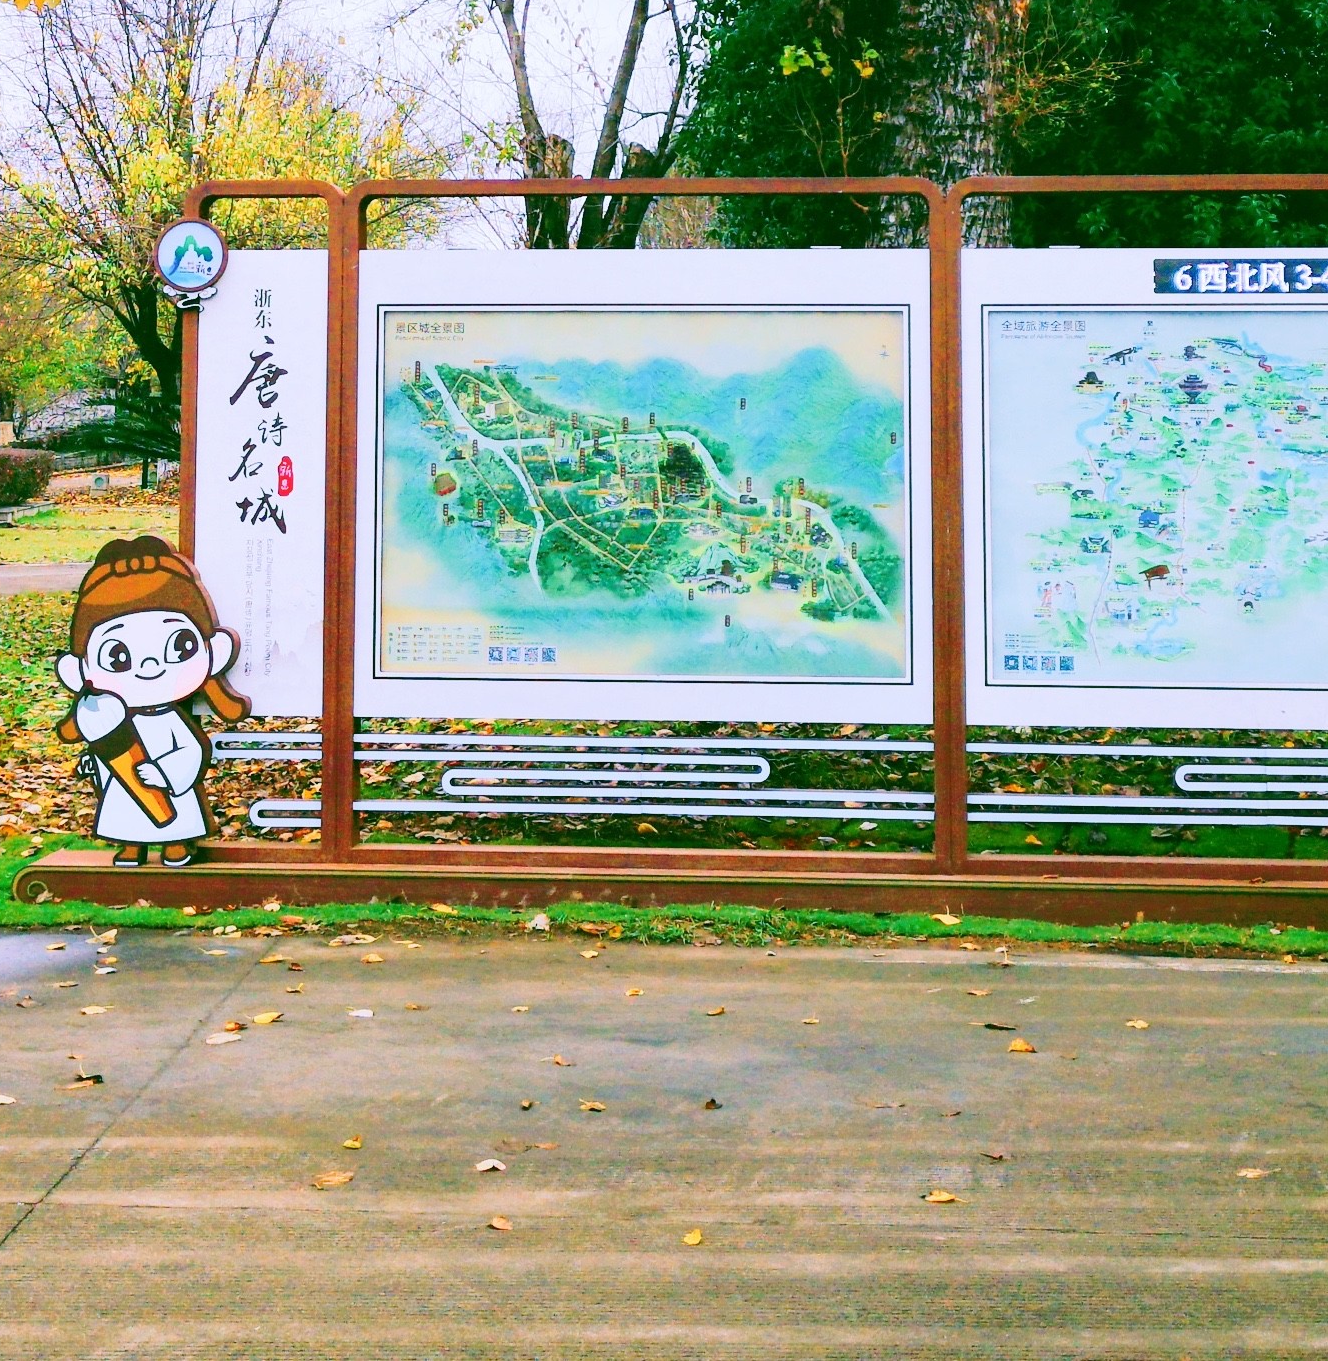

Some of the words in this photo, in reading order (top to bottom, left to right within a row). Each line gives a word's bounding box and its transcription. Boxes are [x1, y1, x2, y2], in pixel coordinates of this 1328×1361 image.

[1173, 264, 1193, 291] 6
[1197, 262, 1290, 293] 西北风
[253, 289, 272, 329] 浙东
[395, 322, 465, 334] 景区城全景图
[1001, 320, 1086, 332] 全域旅游全景图
[229, 335, 289, 535] 唐诗名城
